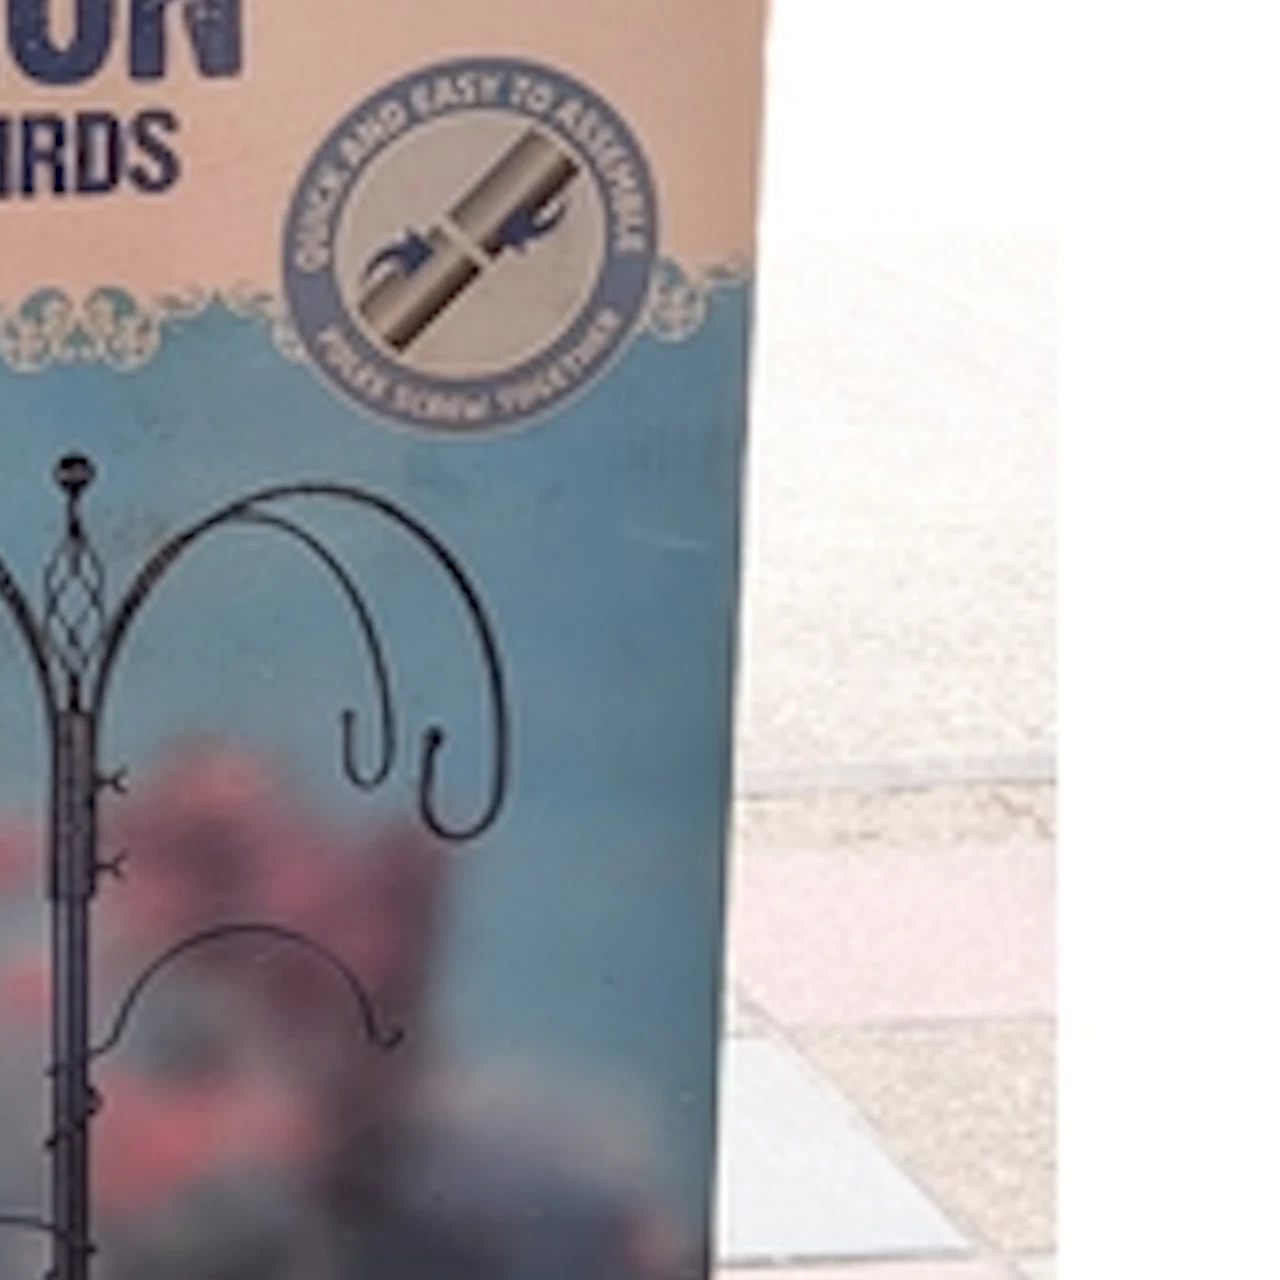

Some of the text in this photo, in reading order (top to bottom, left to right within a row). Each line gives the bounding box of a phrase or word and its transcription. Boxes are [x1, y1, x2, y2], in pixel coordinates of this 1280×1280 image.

[341, 101, 407, 166] AND
[410, 72, 498, 118] EASY
[510, 75, 554, 114] TO
